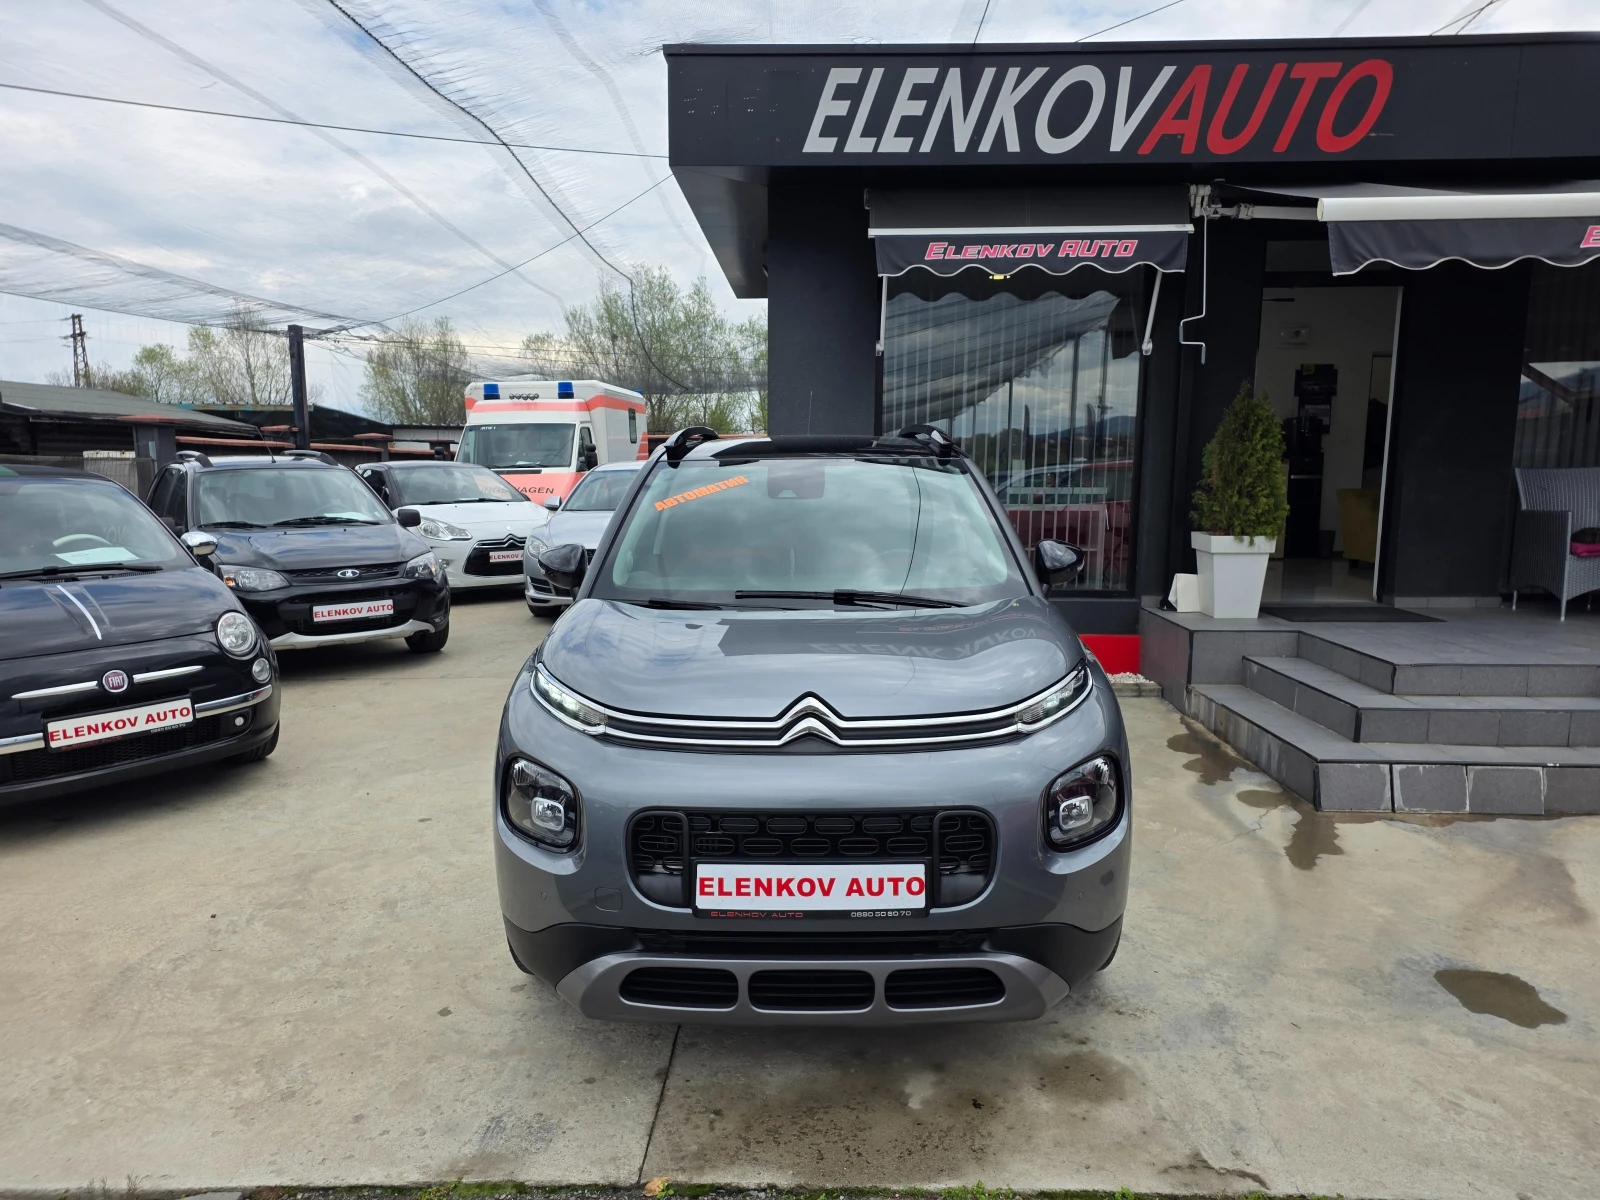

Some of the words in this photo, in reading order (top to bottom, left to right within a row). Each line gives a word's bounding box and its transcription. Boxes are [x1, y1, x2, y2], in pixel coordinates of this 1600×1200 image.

[924, 242, 1054, 260] ELENKOV
[1058, 239, 1138, 258] AUTO
[654, 475, 750, 512] АВТОМАТИК
[314, 606, 363, 618] ELENKOV
[366, 603, 394, 613] AUTO
[108, 675, 124, 688] FIAT
[49, 716, 139, 742] ELENKOV
[145, 706, 191, 725] AUTO
[698, 877, 836, 897] ELENKOV
[845, 876, 926, 897] AUTO
